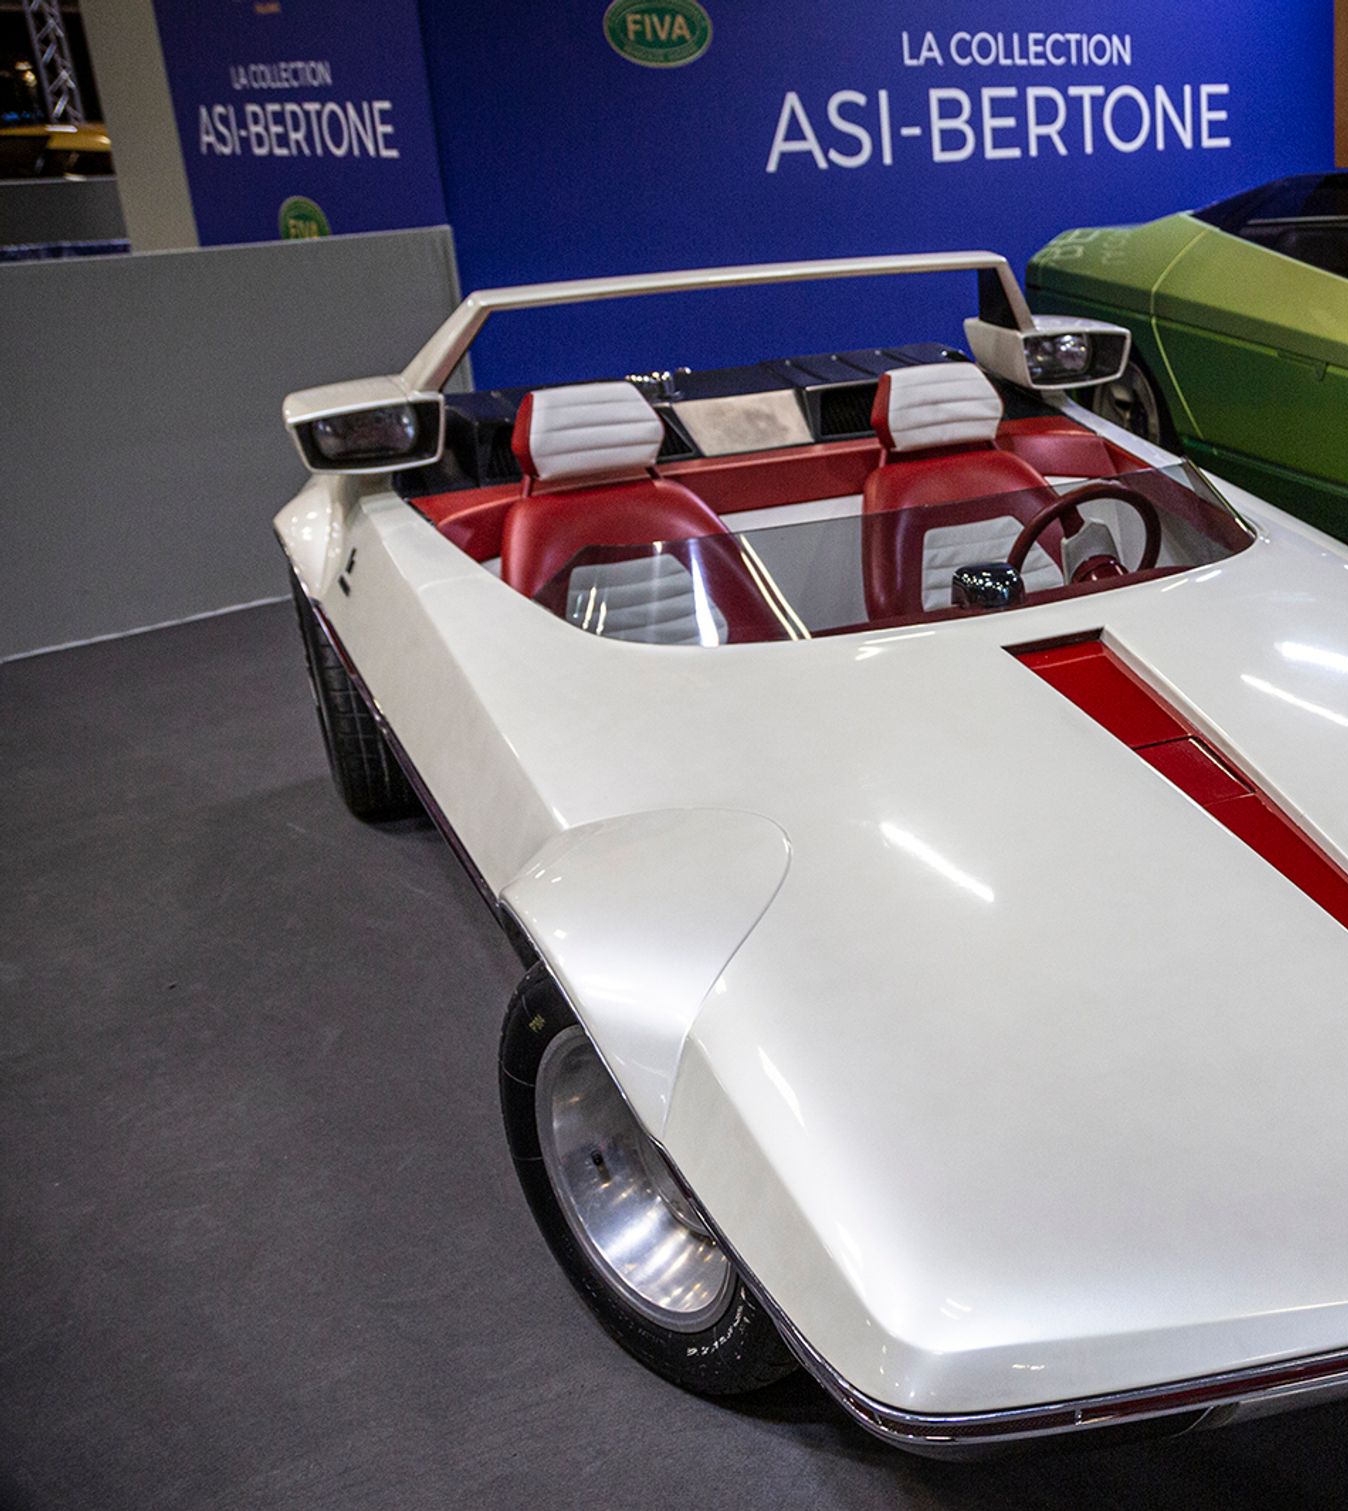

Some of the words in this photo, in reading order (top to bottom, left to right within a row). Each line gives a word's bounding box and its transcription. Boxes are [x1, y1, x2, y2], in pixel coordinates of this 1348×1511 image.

[626, 13, 691, 42] FIVA
[902, 31, 943, 66] LA
[949, 32, 1131, 66] COLLECTION
[230, 64, 248, 90] LA
[249, 61, 332, 88] COLLECTION
[200, 101, 399, 158] ASI-BERTONE
[765, 83, 1231, 173] ASI-BERTONE
